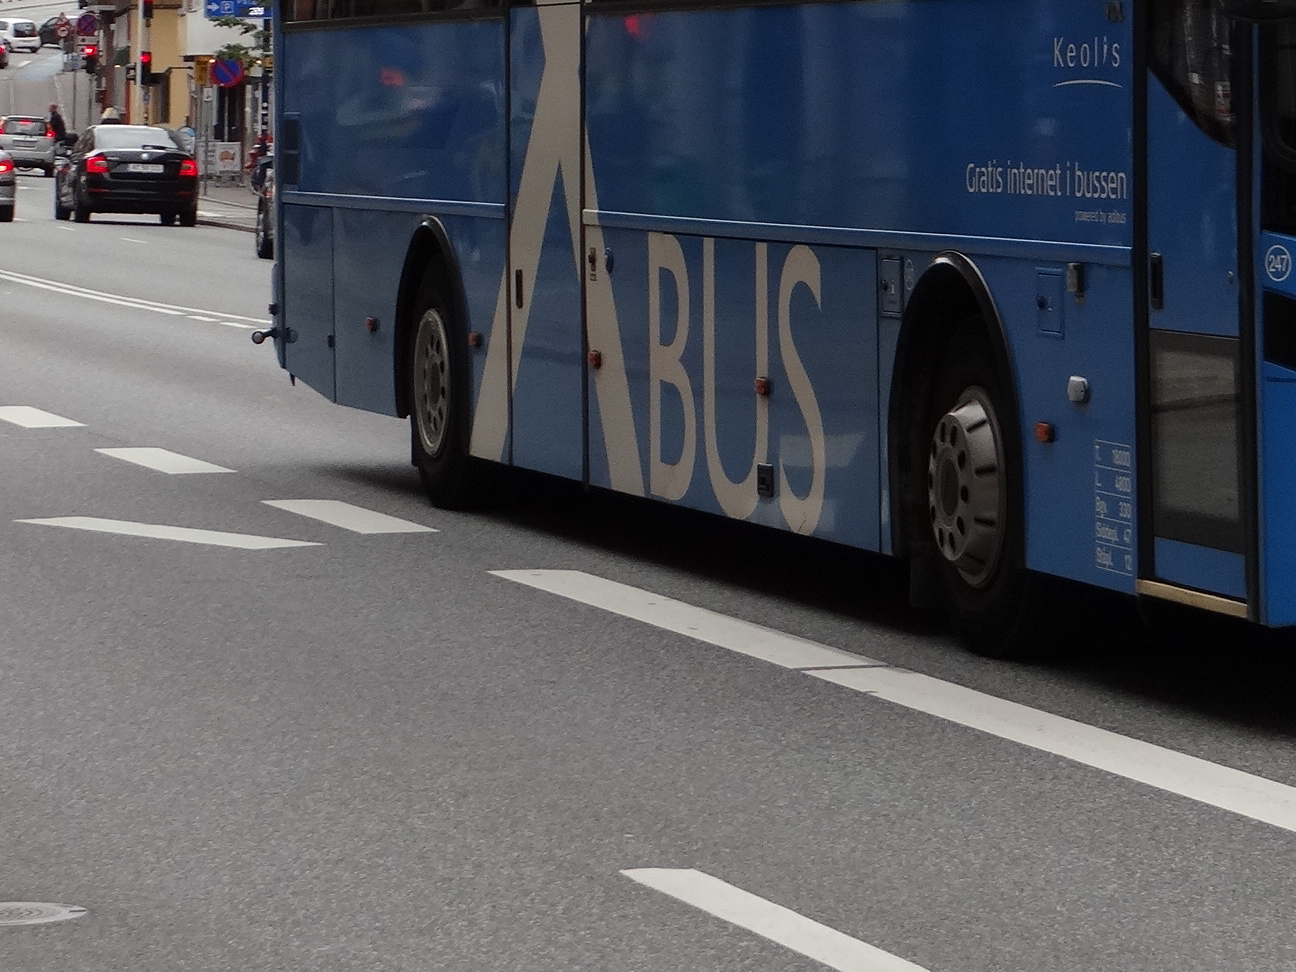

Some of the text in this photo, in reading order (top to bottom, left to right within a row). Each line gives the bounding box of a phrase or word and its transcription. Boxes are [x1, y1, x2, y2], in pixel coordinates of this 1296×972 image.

[1053, 35, 1121, 68] Keolis
[966, 159, 1127, 199] Gratis internet i bussen
[1269, 254, 1288, 272] 247
[647, 231, 826, 536] BUS
